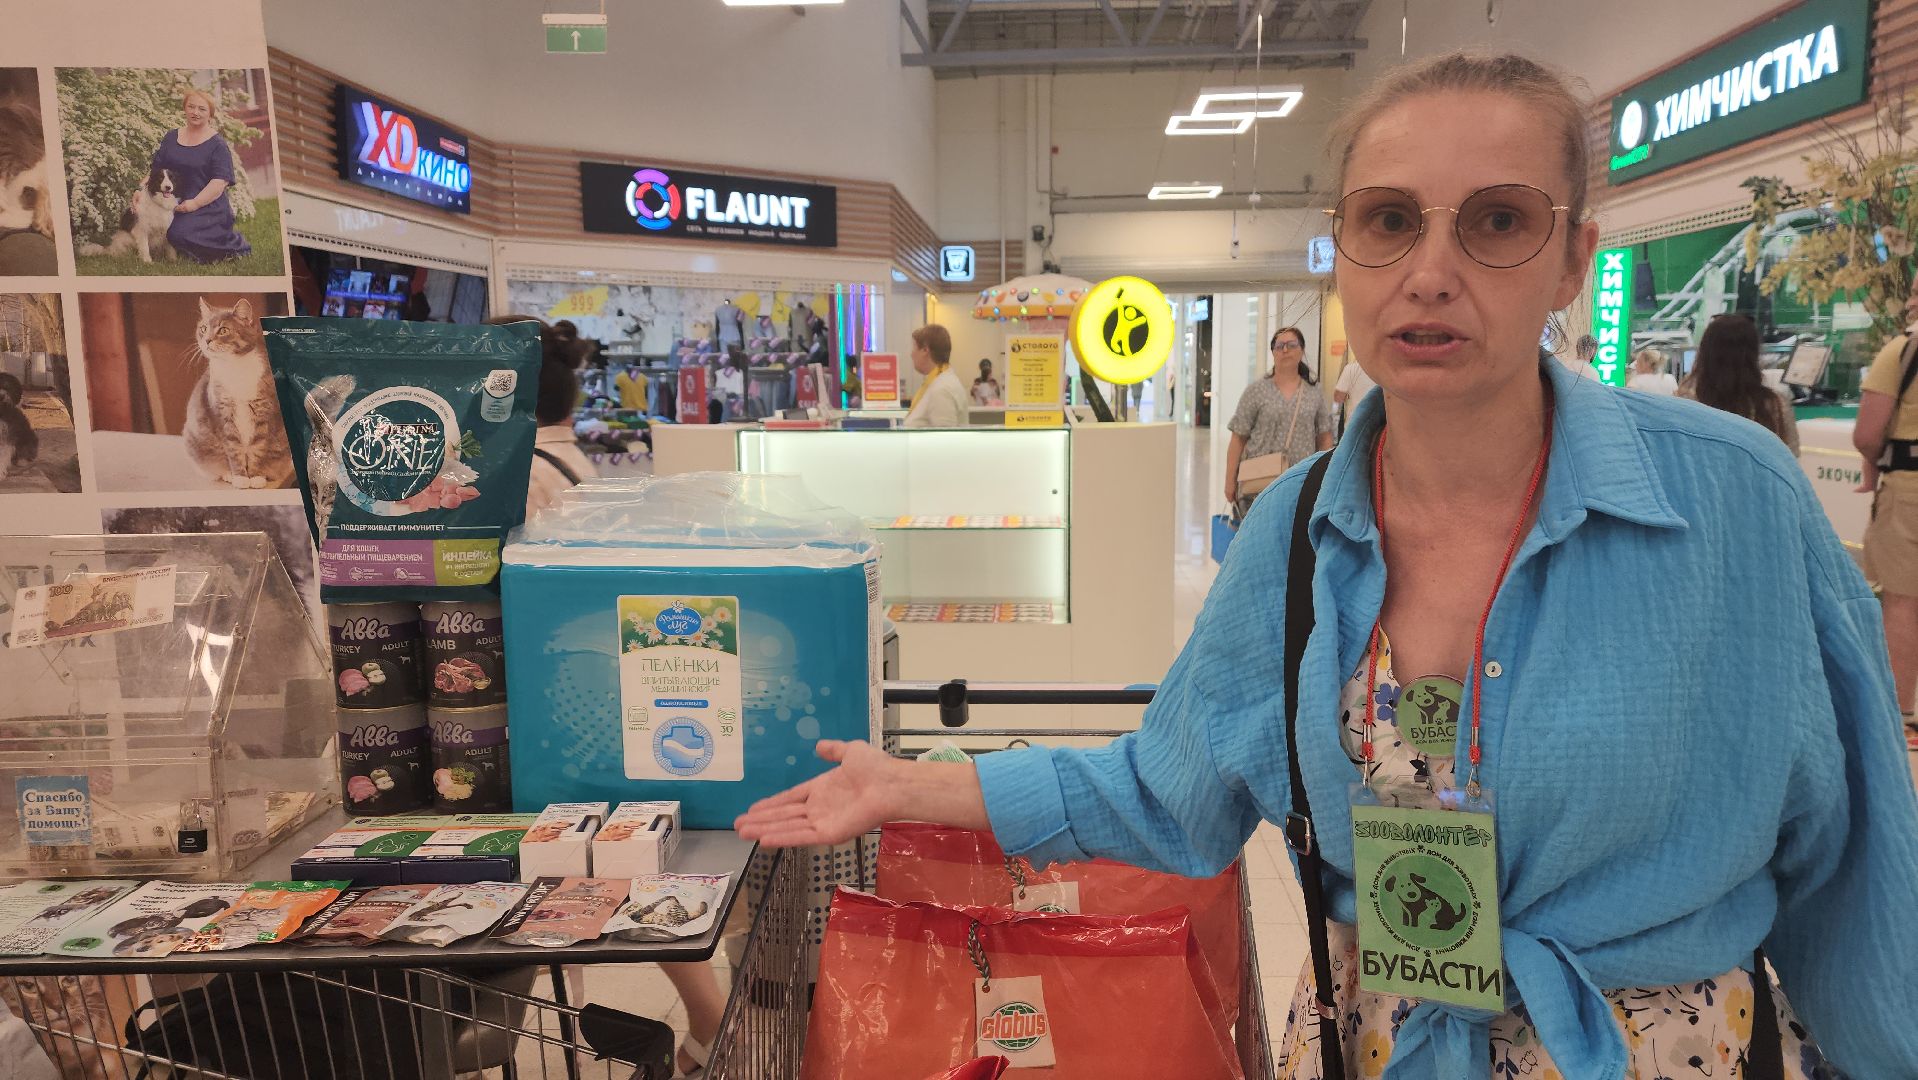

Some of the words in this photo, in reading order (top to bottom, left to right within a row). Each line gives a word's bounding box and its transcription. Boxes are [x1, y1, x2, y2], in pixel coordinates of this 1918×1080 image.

[1653, 24, 1839, 142] ХИМЧИСТКА
[417, 147, 472, 193] КИНО
[686, 187, 810, 229] FLAUNT
[570, 295, 594, 311] 999
[1597, 252, 1625, 387] ХИМЧИСТ
[682, 402, 699, 415] SALE
[340, 524, 396, 532] ПОДДЕРЖИВАЕТ
[367, 553, 423, 562] ПИЩЕВАРЕНИЕМ
[442, 550, 492, 562] ИНДЕЙКА
[49, 585, 73, 597] 100
[381, 641, 409, 651] ADULT
[475, 635, 502, 646] ADULT
[333, 644, 361, 653] TURKEY
[641, 656, 720, 672] ПЕЛЁНКИ
[721, 725, 734, 734] 30
[1410, 726, 1457, 738] БУБАС
[342, 751, 370, 761] TURKEY
[390, 747, 418, 757] ADULT
[465, 747, 493, 756] ADULT
[26, 792, 82, 802] Спасибо
[46, 805, 81, 817] Вашу
[28, 818, 86, 829] помощь!
[1355, 820, 1492, 847] ЗООВОЛОНТЁР
[1363, 949, 1501, 997] БУБАСТИ
[982, 1010, 1047, 1039] Globus
